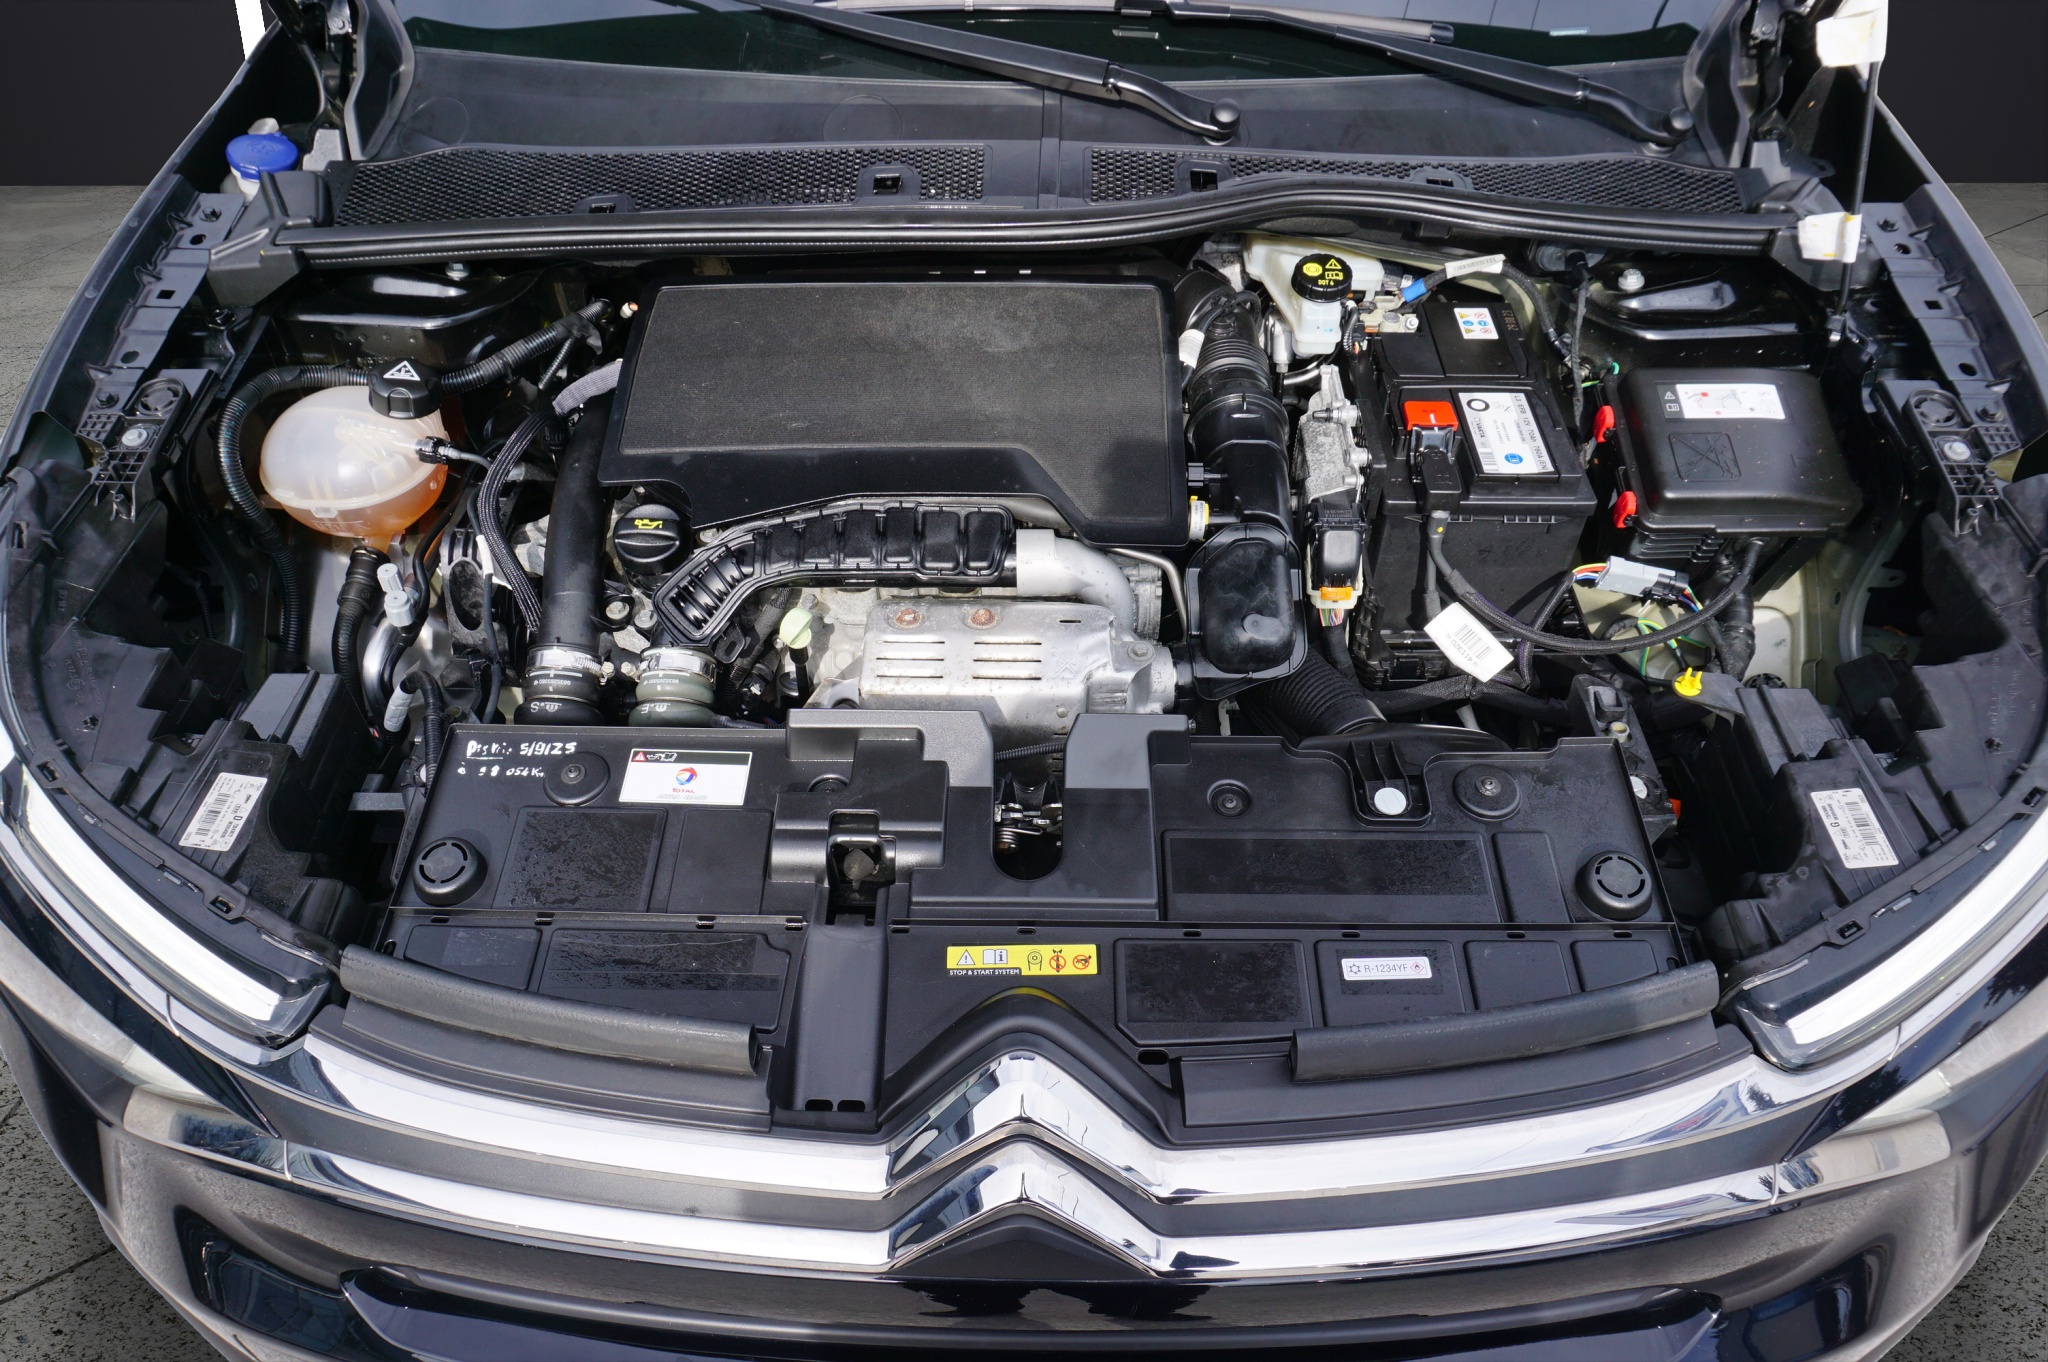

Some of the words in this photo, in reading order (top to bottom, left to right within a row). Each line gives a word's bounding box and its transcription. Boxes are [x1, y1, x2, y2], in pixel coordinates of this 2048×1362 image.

[1517, 404, 1527, 415] EFB
[1523, 417, 1532, 427] 12V
[1476, 422, 1486, 439] VARTA
[1527, 429, 1537, 443] 70Ah
[1538, 459, 1549, 471] (EN)
[1450, 639, 1473, 662] 411320
[520, 741, 577, 756] 5/9/25
[1363, 963, 1408, 973] R-1234YF
